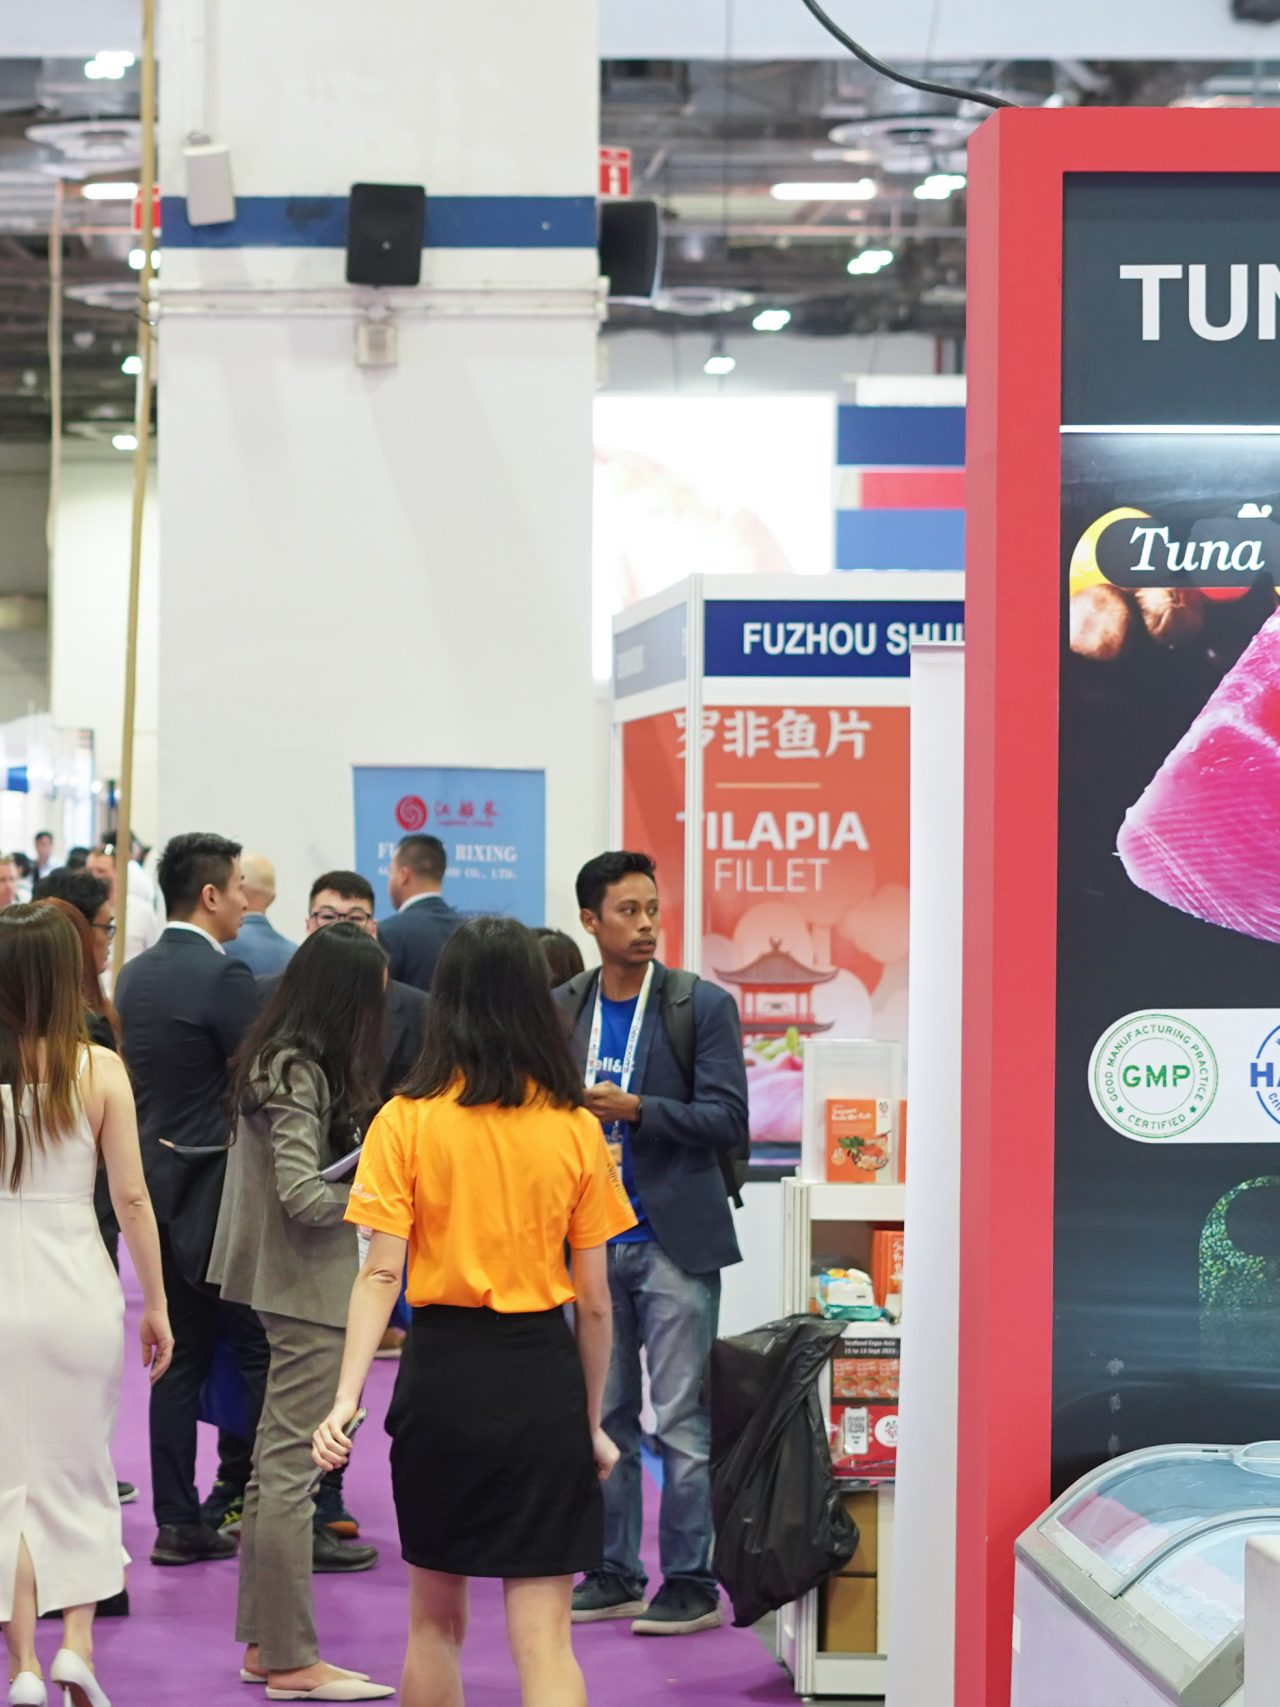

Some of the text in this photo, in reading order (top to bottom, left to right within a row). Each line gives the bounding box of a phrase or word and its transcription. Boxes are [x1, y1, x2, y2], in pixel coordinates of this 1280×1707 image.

[1130, 526, 1265, 571] Tuna
[743, 622, 877, 655] FUZHOU
[455, 844, 517, 862] RIXING
[715, 858, 829, 892] FILLET
[1104, 1023, 1209, 1102] GOOD MANUFACTURING PRACTICE
[1122, 1064, 1191, 1088] GMP
[1250, 1062, 1280, 1088] H
[1127, 1113, 1186, 1130] CERTIFIED
